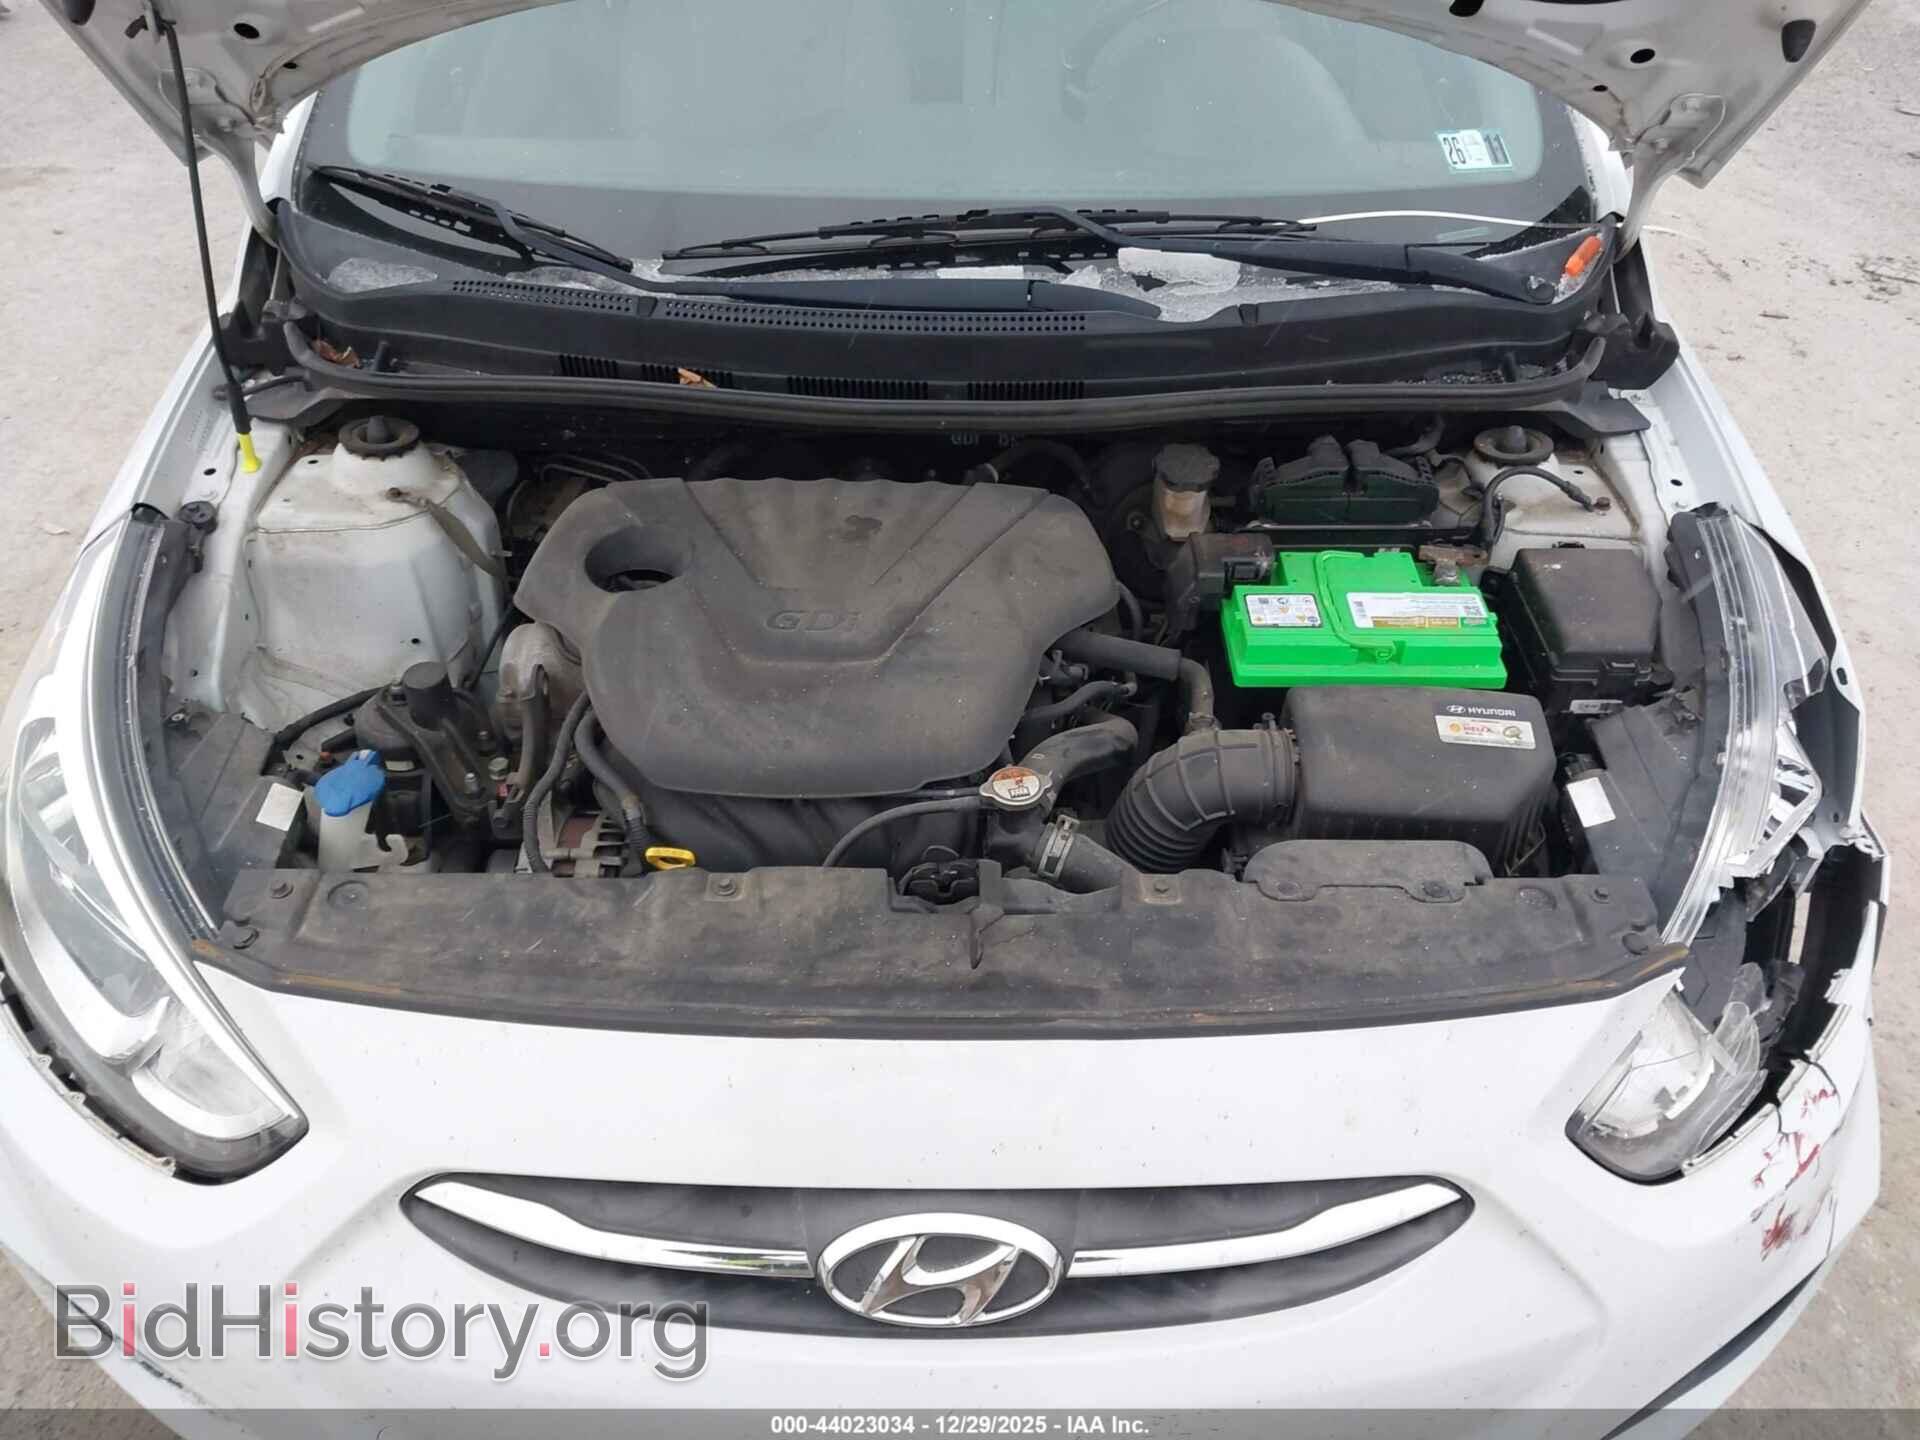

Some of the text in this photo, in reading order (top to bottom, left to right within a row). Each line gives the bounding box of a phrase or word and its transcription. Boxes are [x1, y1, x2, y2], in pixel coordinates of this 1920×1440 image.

[1442, 136, 1467, 165] 26
[1483, 133, 1510, 164] 11
[1467, 706, 1517, 718] HYUNDAI
